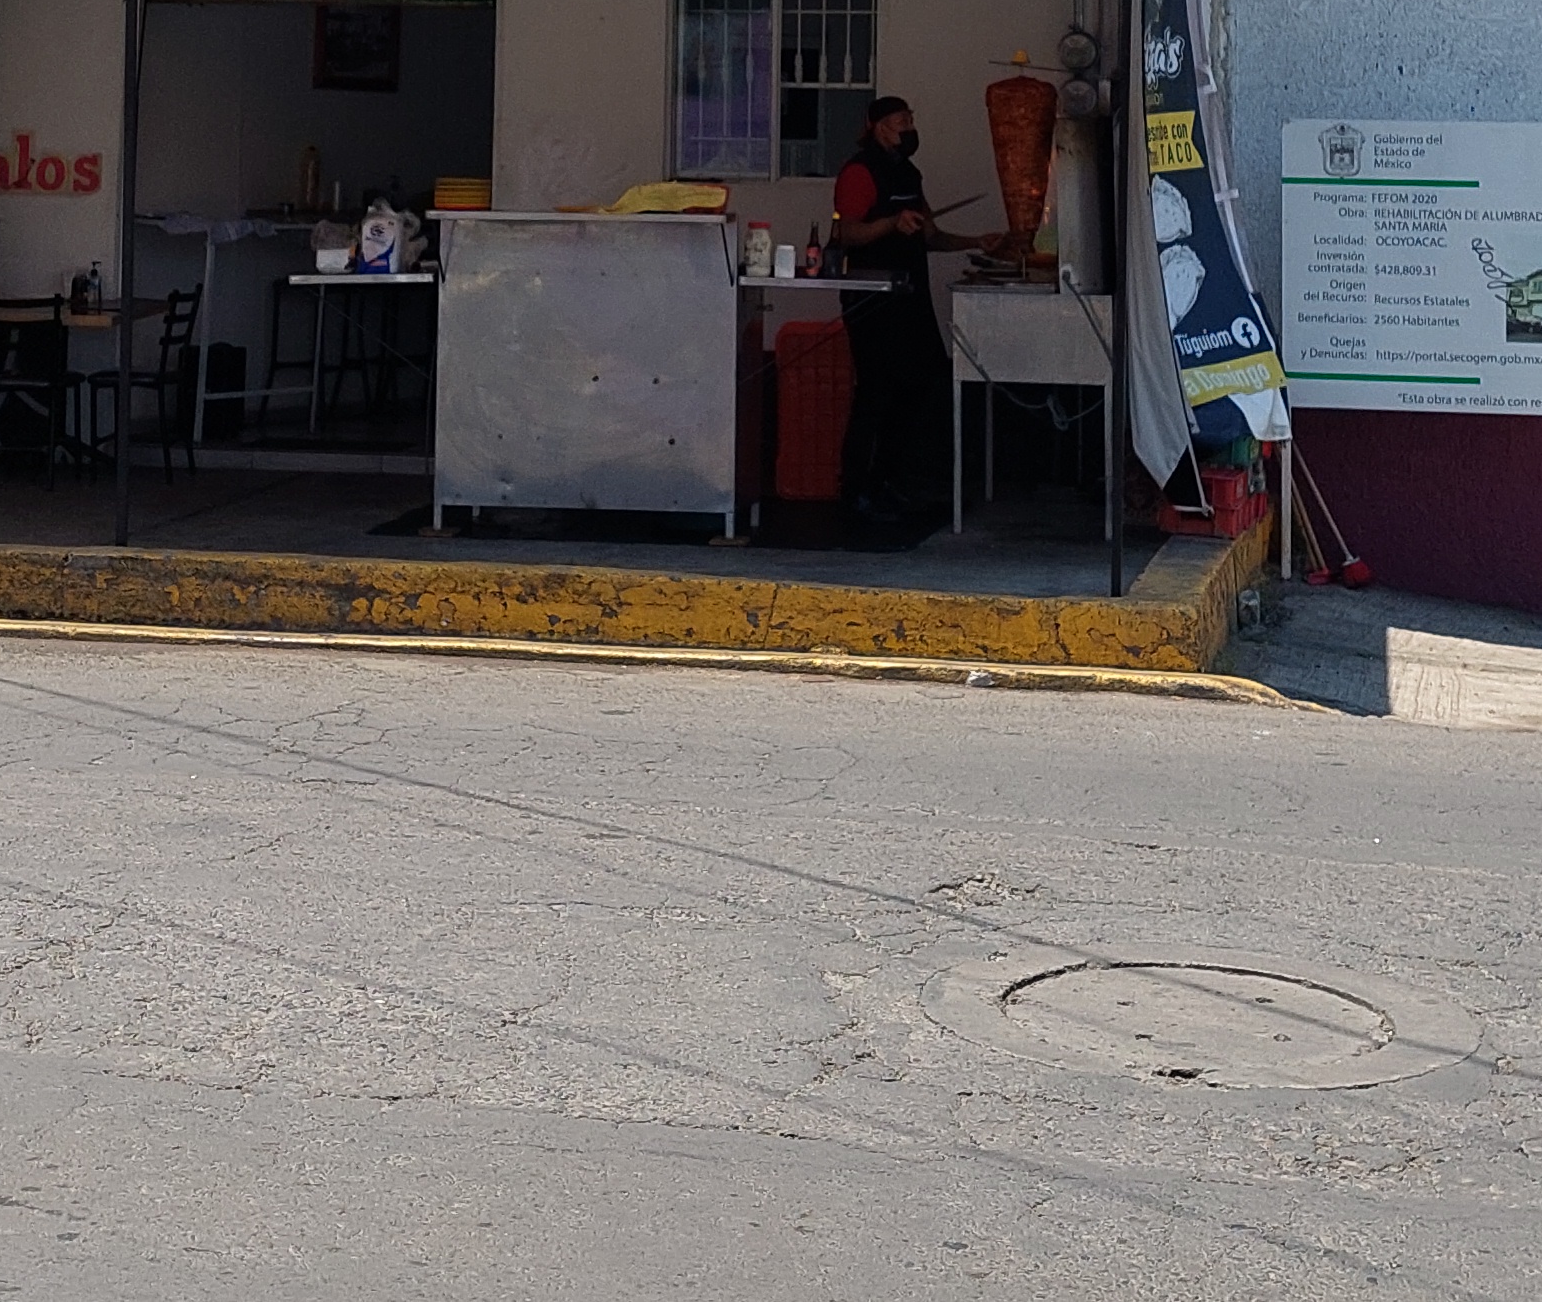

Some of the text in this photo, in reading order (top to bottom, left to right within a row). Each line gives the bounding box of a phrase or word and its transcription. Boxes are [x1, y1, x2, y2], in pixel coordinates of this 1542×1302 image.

[1171, 123, 1188, 140] con
[1373, 134, 1443, 145] Gobierno del
[1374, 147, 1425, 157] Estado de
[1374, 159, 1412, 169] México
[1313, 192, 1438, 204] Programa: FEFOM 2020
[1338, 207, 1368, 218] Obra:
[1374, 208, 1461, 220] REHABILITACIÓN
[1465, 210, 1477, 221] DE
[1374, 222, 1409, 232] SANTA
[1313, 235, 1367, 246] Localidad:
[1317, 250, 1365, 261] Inversión
[1308, 263, 1368, 274] contratada:
[1330, 279, 1366, 291] Origen
[1303, 291, 1470, 307] del Recurso: Recursos Estatales
[1297, 312, 1460, 327] Beneficiarios: 2560 Habitantes
[1330, 337, 1366, 349] Quejas
[1300, 350, 1307, 360] y
[1310, 348, 1367, 360] Denuncias:
[1194, 364, 1270, 391] Domingo
[1427, 393, 1452, 405] obra
[1454, 397, 1467, 406] se
[1469, 395, 1505, 407] realizó
[1508, 398, 1528, 408] con
